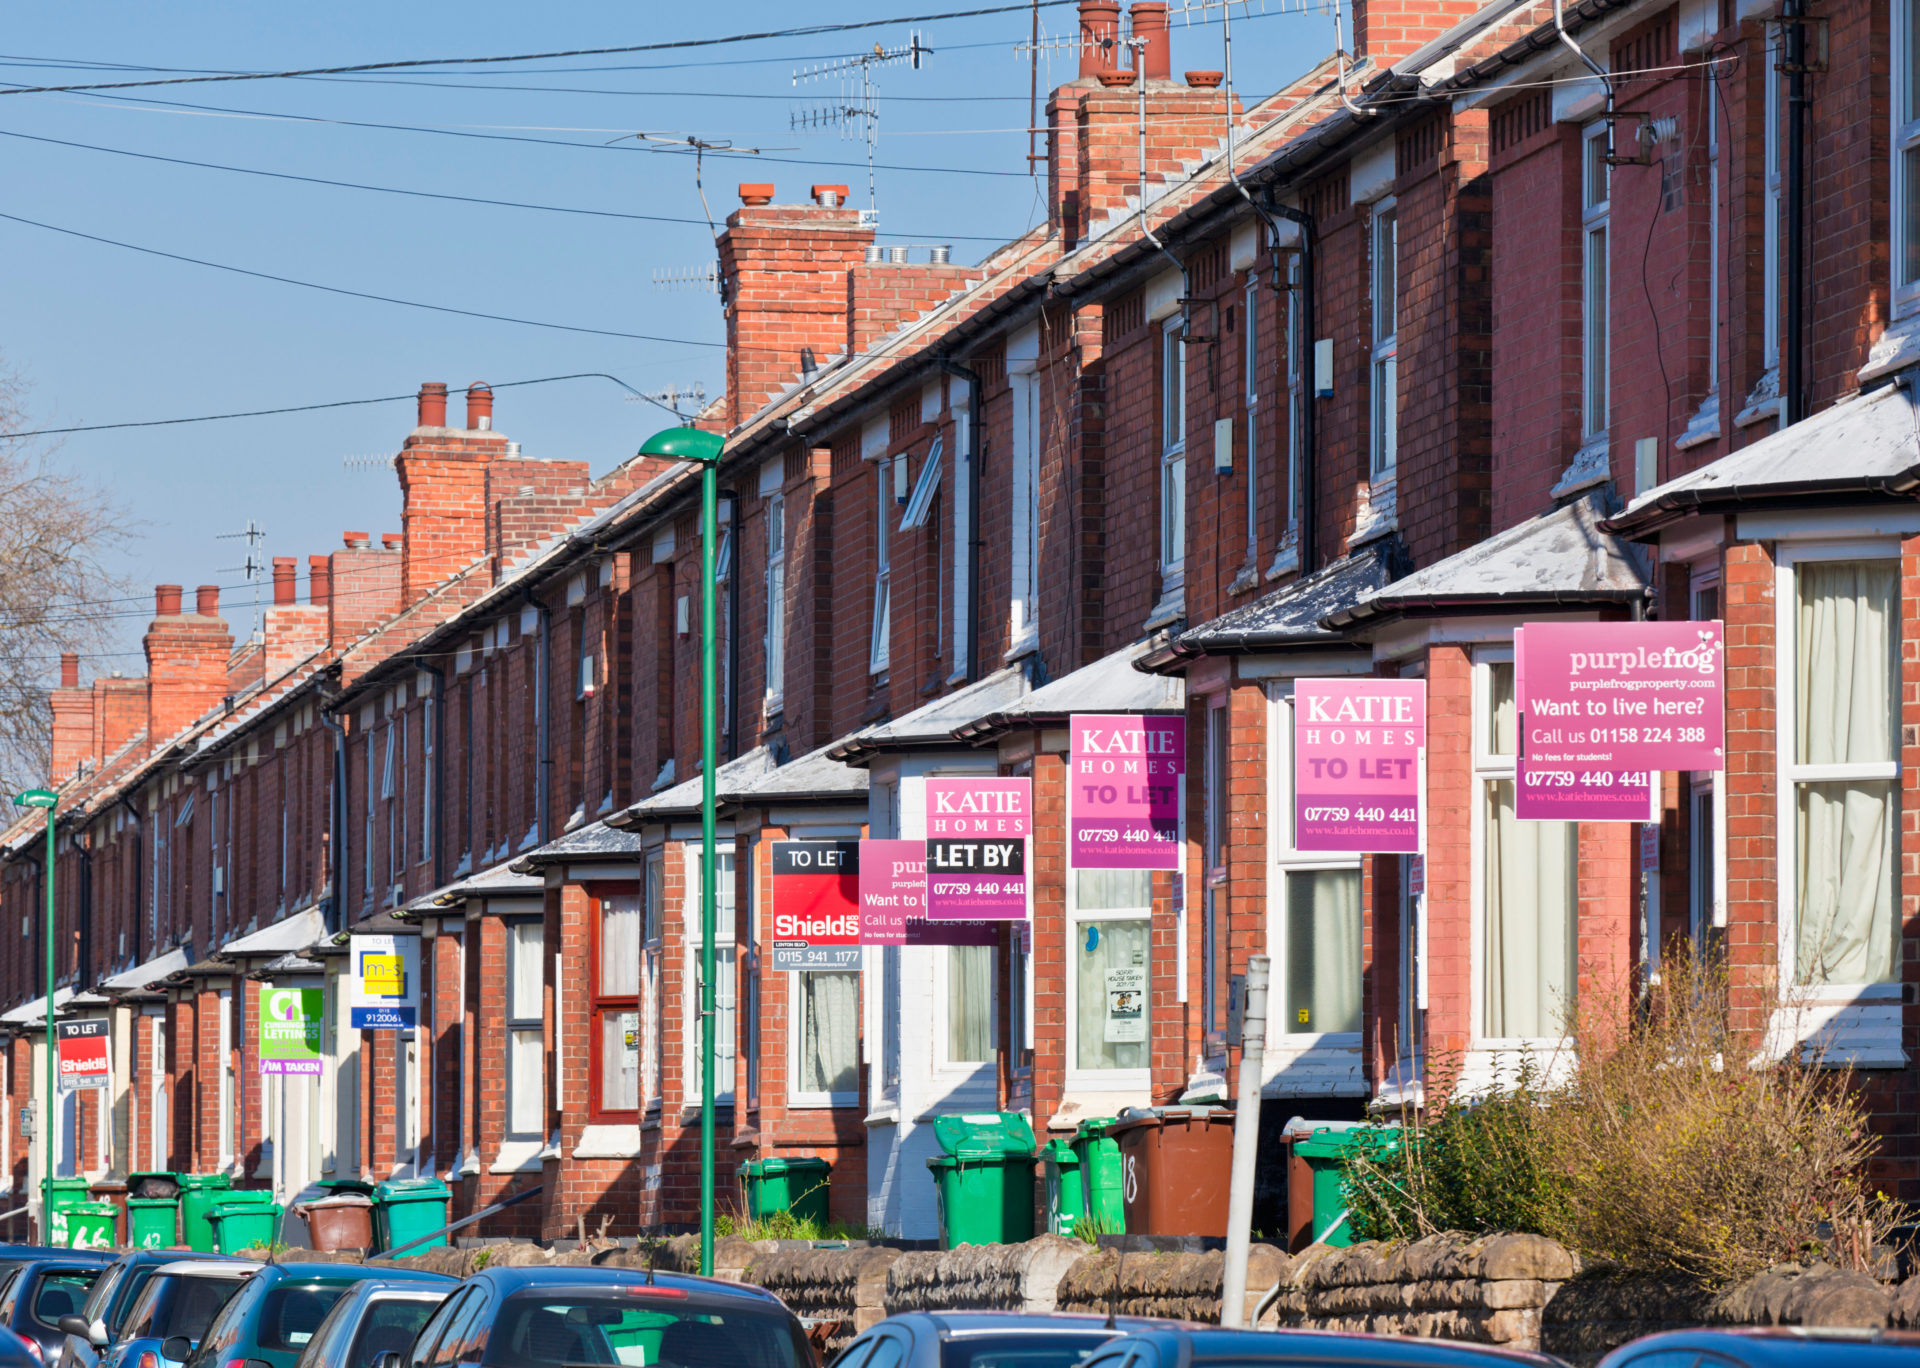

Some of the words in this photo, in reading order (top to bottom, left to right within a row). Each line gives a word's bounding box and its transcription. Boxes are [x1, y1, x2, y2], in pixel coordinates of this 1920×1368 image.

[1570, 644, 1715, 675] purplefrog
[1570, 678, 1715, 691] purplefrogproperty.com
[1307, 696, 1414, 722] KATIE
[1531, 699, 1580, 716] Want
[1587, 700, 1606, 715] to
[1613, 698, 1647, 715] live
[1653, 697, 1705, 714] here?
[1081, 730, 1175, 754] KATIE
[1306, 730, 1415, 745] HOMES
[1532, 728, 1563, 744] Call
[1568, 731, 1586, 743] us
[1590, 728, 1638, 743] 01158
[1643, 727, 1672, 743] 224
[1677, 727, 1706, 742] 388
[1532, 753, 1543, 761] No
[1544, 752, 1561, 761] fees
[1563, 752, 1575, 761] for
[1576, 752, 1613, 761] students!
[1080, 760, 1176, 774] HOMES
[1309, 758, 1348, 779] TO
[1360, 758, 1412, 779] LET
[1525, 771, 1574, 787] 07759
[1580, 771, 1614, 786] 440
[1618, 771, 1648, 787] 441
[935, 791, 1022, 813] KATIE
[1083, 785, 1117, 804] TO
[1127, 785, 1174, 805] LET
[1526, 792, 1648, 803] www.katiehomes.co.uk
[1304, 807, 1349, 821] 07759
[1354, 807, 1384, 821] 440
[1389, 807, 1416, 821] 441
[935, 819, 1024, 832] HOMES
[1305, 826, 1415, 836] www.katiehomes.co.uk
[1078, 829, 1118, 842] 07759
[1123, 829, 1149, 842] 440
[1153, 829, 1176, 842] 441
[936, 844, 978, 867] LET
[983, 844, 1014, 867] BY
[1079, 845, 1176, 855] www.katiehomes.co.uk
[788, 851, 812, 867] TO
[818, 850, 847, 867] LET
[934, 882, 970, 895] 07759
[975, 882, 999, 895] 440
[1003, 882, 1025, 895] 441
[865, 894, 899, 906] Want
[903, 894, 918, 906] to
[934, 898, 1025, 906] www.katiehomes.co.uk
[775, 915, 859, 936] Shields
[865, 914, 887, 926] Call
[890, 916, 903, 926] us
[778, 951, 802, 962] 0115
[807, 951, 828, 962] 941
[835, 951, 859, 962] 1177
[366, 963, 401, 977] m-s
[66, 1026, 79, 1035] TO
[82, 1024, 98, 1034] LET
[264, 1029, 318, 1039] LETTINGS
[61, 1058, 107, 1072] Shields
[284, 1062, 320, 1072] TAKEN
[1123, 1153, 1137, 1204] 18
